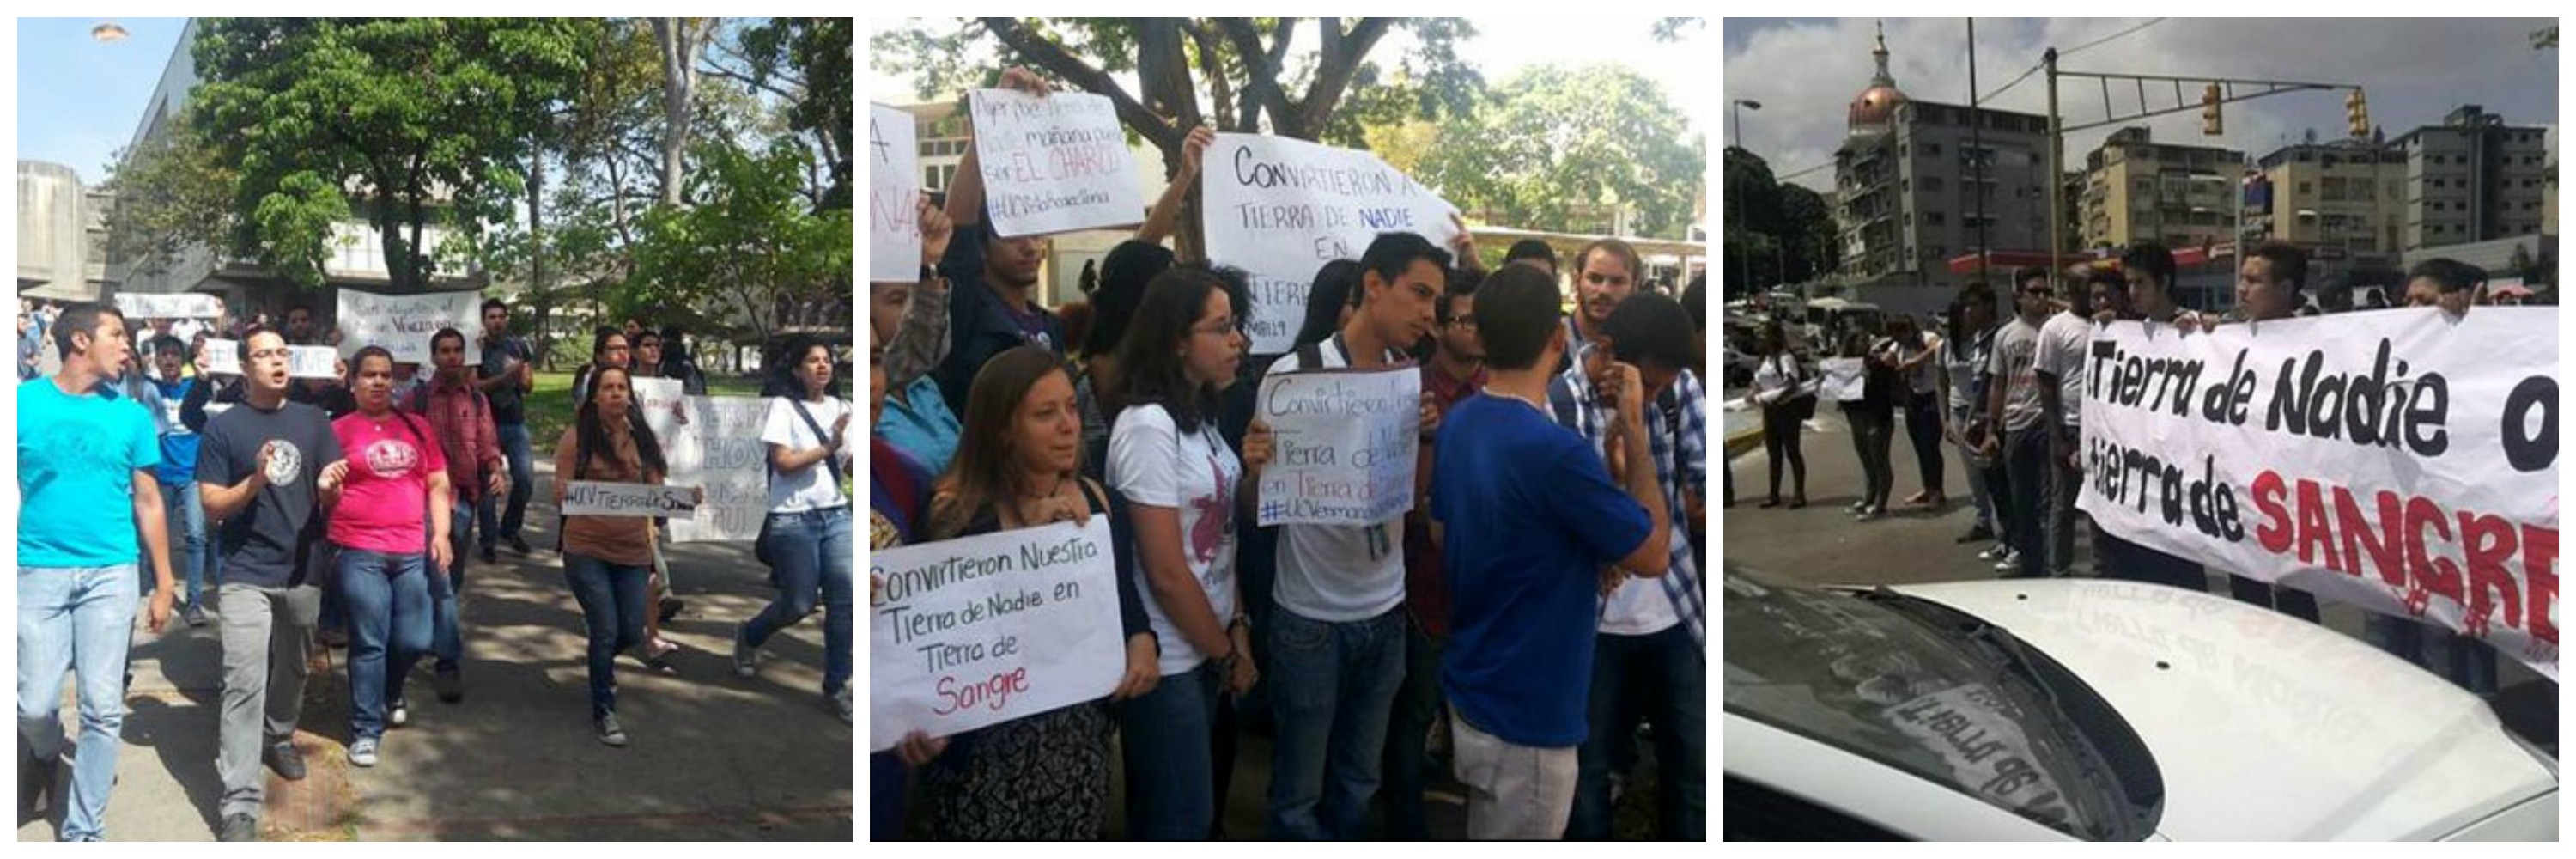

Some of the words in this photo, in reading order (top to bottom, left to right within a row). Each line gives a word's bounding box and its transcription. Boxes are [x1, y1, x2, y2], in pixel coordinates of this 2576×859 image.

[1025, 125, 1091, 148] mañana
[1012, 149, 1045, 182] EL
[1235, 145, 1392, 197] CONVIRTIERON
[1236, 203, 1315, 229] TIERRA
[1325, 204, 1350, 228] DE
[1358, 206, 1414, 228] NADIE
[1314, 235, 1349, 260] EN
[2088, 340, 2204, 417] Tierra
[2202, 348, 2257, 426] de
[2266, 338, 2449, 456] Nadie
[702, 437, 766, 471] HOY
[1272, 429, 1336, 466] Tierra
[1289, 469, 1352, 498] Tierra
[2092, 437, 2182, 526] tierra
[2190, 455, 2245, 543] de
[2251, 470, 2559, 642] SANGRE
[870, 554, 1012, 607] Convirtieron
[1020, 536, 1098, 571] Nuestra
[879, 605, 957, 645] Tierra
[961, 603, 985, 626] de
[988, 589, 1043, 620] Nadie
[1054, 582, 1080, 602] en
[916, 642, 986, 673] Tierra
[992, 635, 1019, 659] de
[933, 666, 1030, 716] Sangre
